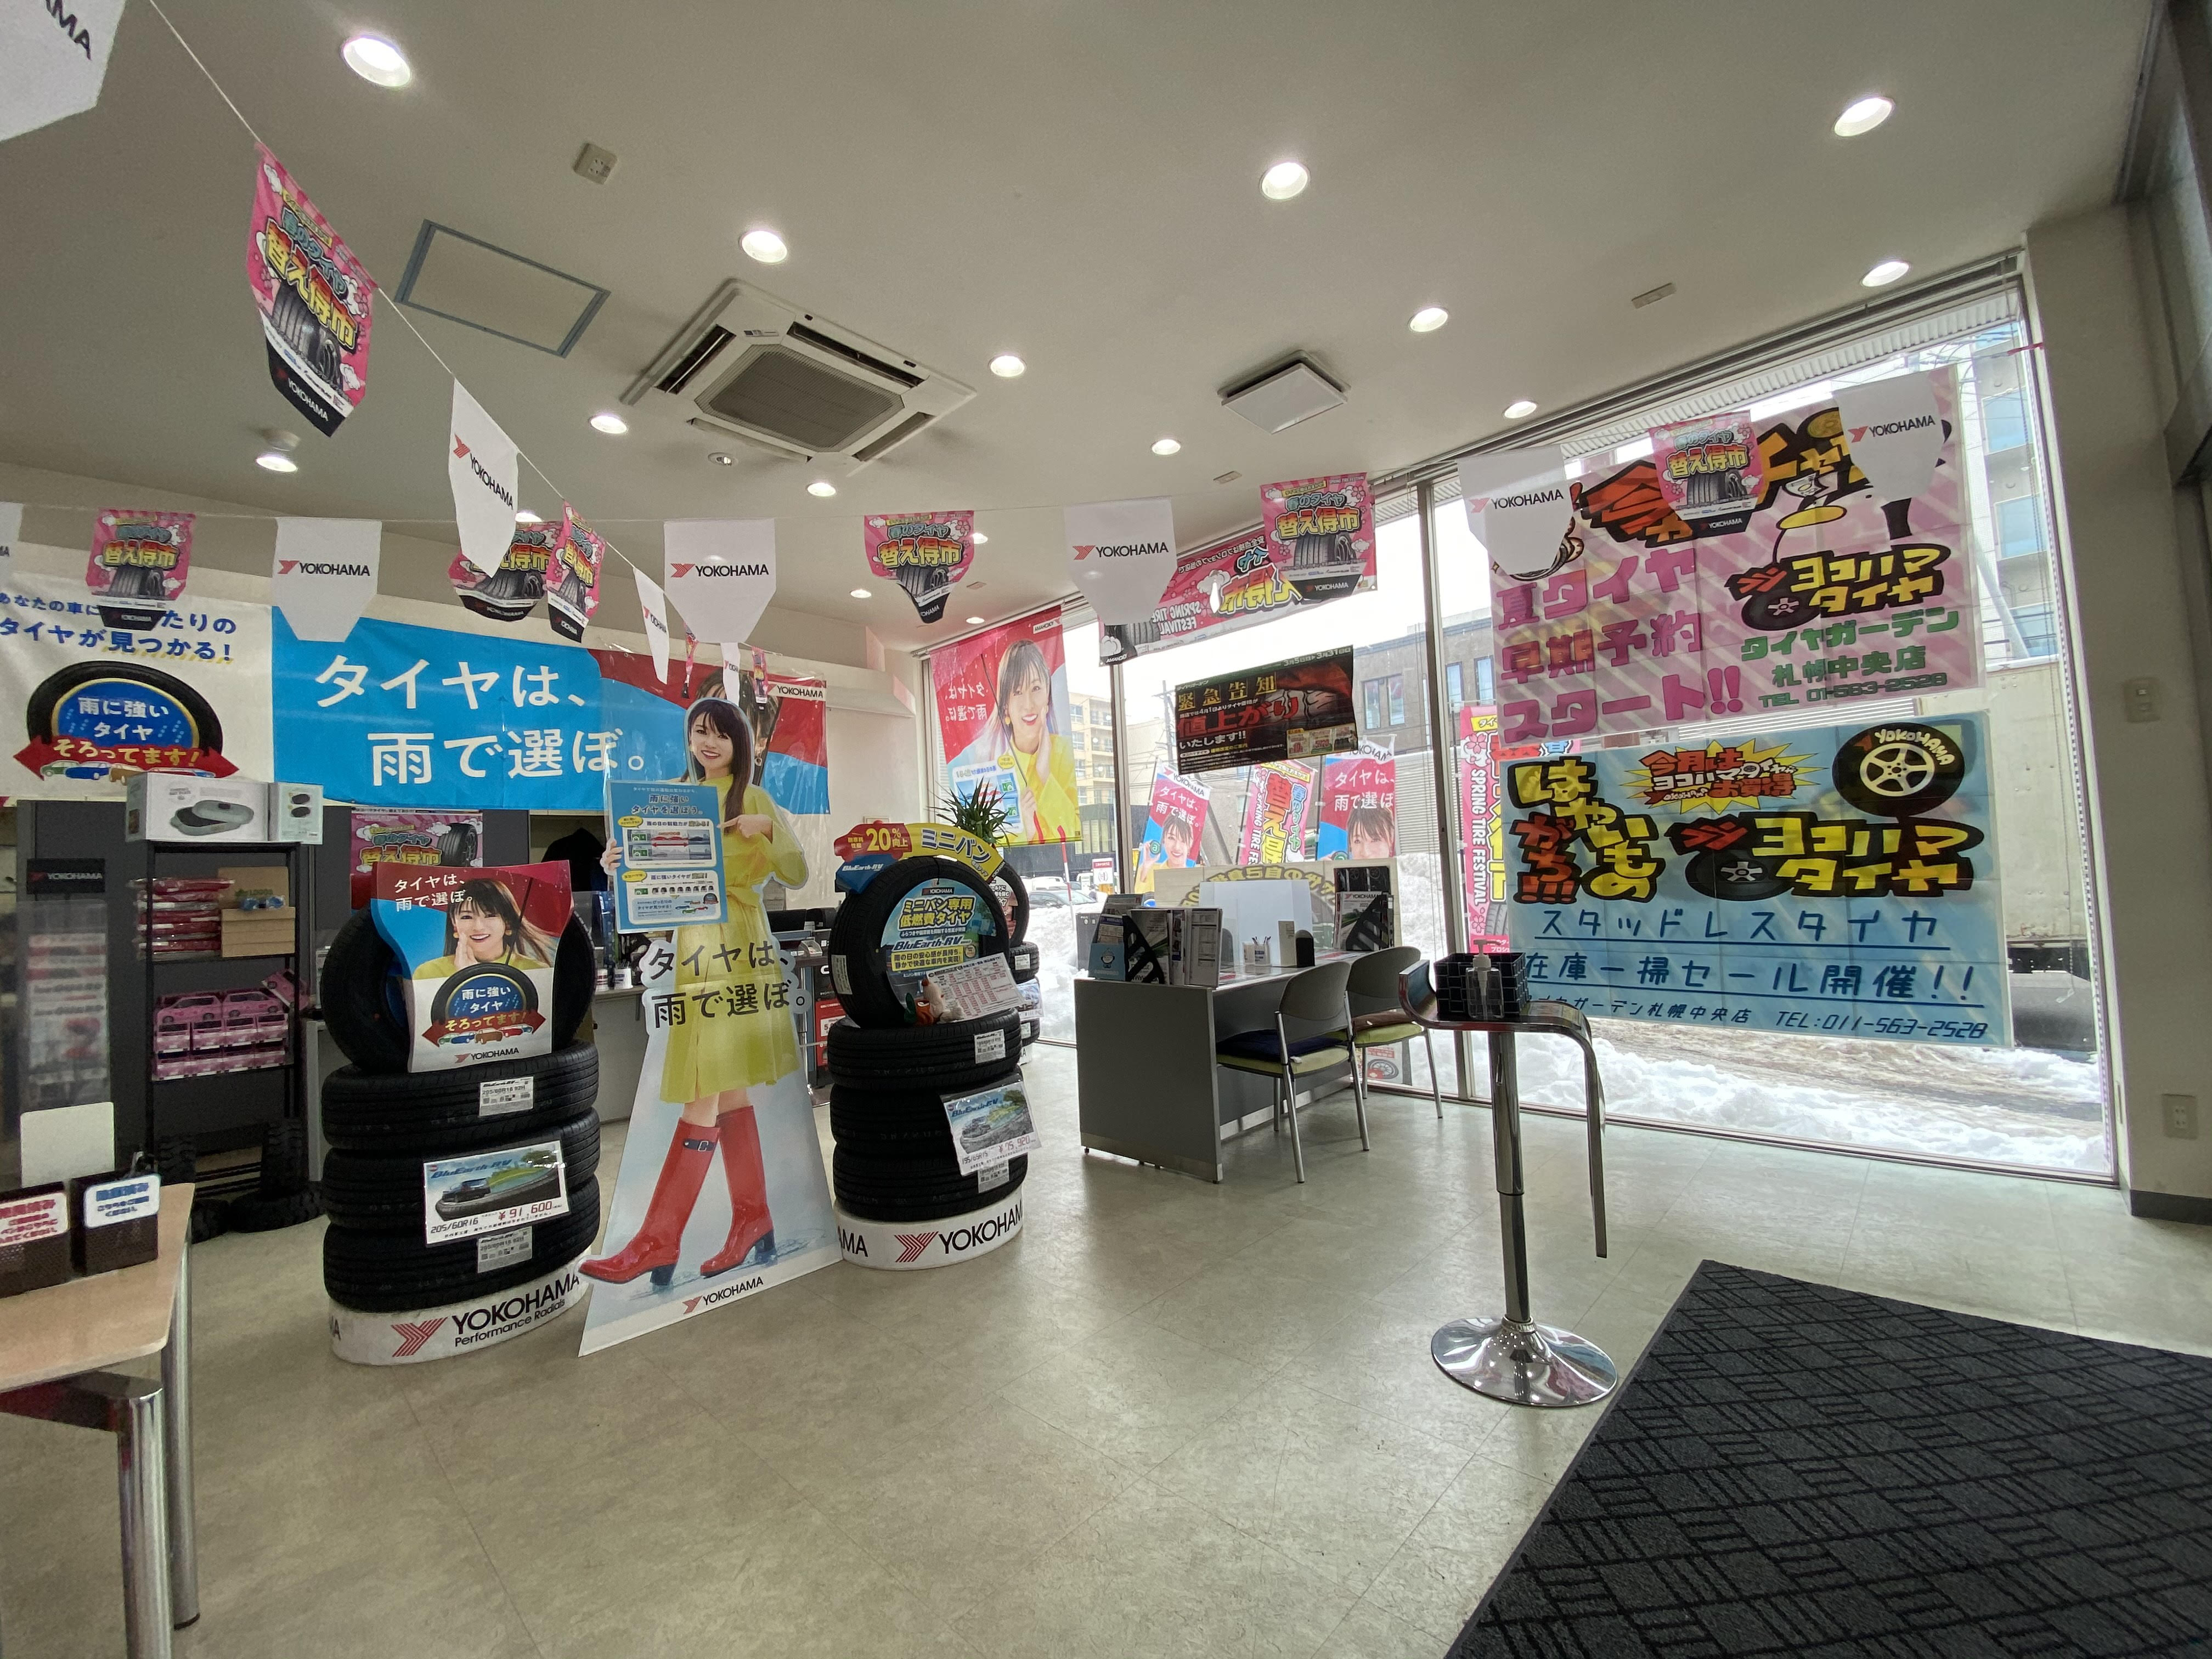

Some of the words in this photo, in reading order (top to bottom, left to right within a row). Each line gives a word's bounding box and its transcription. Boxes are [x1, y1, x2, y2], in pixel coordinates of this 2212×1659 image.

[266, 218, 357, 350] 替え得市
[288, 377, 329, 421] YOKOHAMA
[1869, 415, 1936, 437] YOKOHAMA
[1667, 444, 1747, 477] 替え得市
[470, 453, 513, 510] YOKOHAMA
[1491, 489, 1564, 509] YOKOHAMA
[1276, 507, 1359, 538] 替え得市
[1709, 518, 1742, 528] YOKOHAMA
[878, 537, 962, 566] 替え得市
[1096, 542, 1169, 558] YOKOHAMA
[300, 562, 370, 577] YOKOHAMA
[695, 564, 769, 577] YOKOHAMA
[1791, 548, 1940, 592] ヨコハマ
[1315, 583, 1348, 591] YOKOHAMA
[1497, 549, 1695, 630] 夏タイヤ
[1809, 575, 1933, 613] タイヤ
[1501, 611, 1702, 684] 早期予約
[1741, 607, 1959, 661] タイヤガーデン
[1772, 645, 1926, 687] 札幌中央店
[316, 654, 584, 709] タイヤは、
[777, 685, 823, 698] YOKOHAMA
[1178, 675, 1276, 710] 緊急告知
[78, 697, 168, 718] 雨に強い
[1504, 665, 1743, 743] スタート!!
[1758, 692, 1799, 708] TEL
[94, 721, 154, 740] タイヤ
[1178, 697, 1299, 736] 値上がり
[1479, 718, 1497, 728] タイ
[53, 738, 200, 765] そろってます!
[1180, 730, 1246, 749] いたします!!
[1875, 729, 1955, 765] YOKOHAMA
[368, 728, 644, 786] 雨で選ぼ。
[1639, 747, 1744, 776] 今月は
[650, 794, 689, 803] 雨に強い
[1159, 786, 1198, 811] タイヤは、
[1173, 773, 1204, 796] YOKOHAMA
[1470, 769, 1486, 815] SPRING
[1708, 773, 1797, 798] お買得
[1155, 801, 1199, 827] 雨で選ぼ。
[1254, 789, 1264, 827] SPRING
[892, 838, 908, 848] 向上
[922, 829, 991, 863] ミニバン
[1250, 829, 1261, 850] TIRE
[1472, 819, 1486, 845] TIRE
[1752, 817, 1968, 856] ヨコハマ
[394, 873, 465, 893] タイヤは、
[1472, 848, 1487, 905] FESTIVAL
[1776, 859, 1959, 891] タイヤ
[396, 889, 473, 912] 雨で選ぼ。
[904, 897, 974, 913] ミニバン専用
[900, 911, 972, 928] 低燃費タイヤ
[1543, 909, 1937, 943] スタッドレスタイヤ
[894, 936, 962, 951] BluEarth-RV
[651, 940, 789, 980] タイヤは、
[1526, 952, 1974, 1001] 在庫一掃セール開催!!
[462, 986, 511, 1000] 雨に強い
[470, 1001, 503, 1013] タイヤ
[652, 980, 805, 1029] 雨で選ぼ。
[445, 1012, 526, 1032] そろってます!
[471, 1047, 520, 1061] YOKOHAMA
[431, 1217, 479, 1234] 205/60R16
[452, 1271, 580, 1335] YOKOHAMA
[703, 1276, 764, 1305] YOKOHAMA
[455, 1316, 532, 1347] Performance
[534, 1297, 566, 1321] Radials
